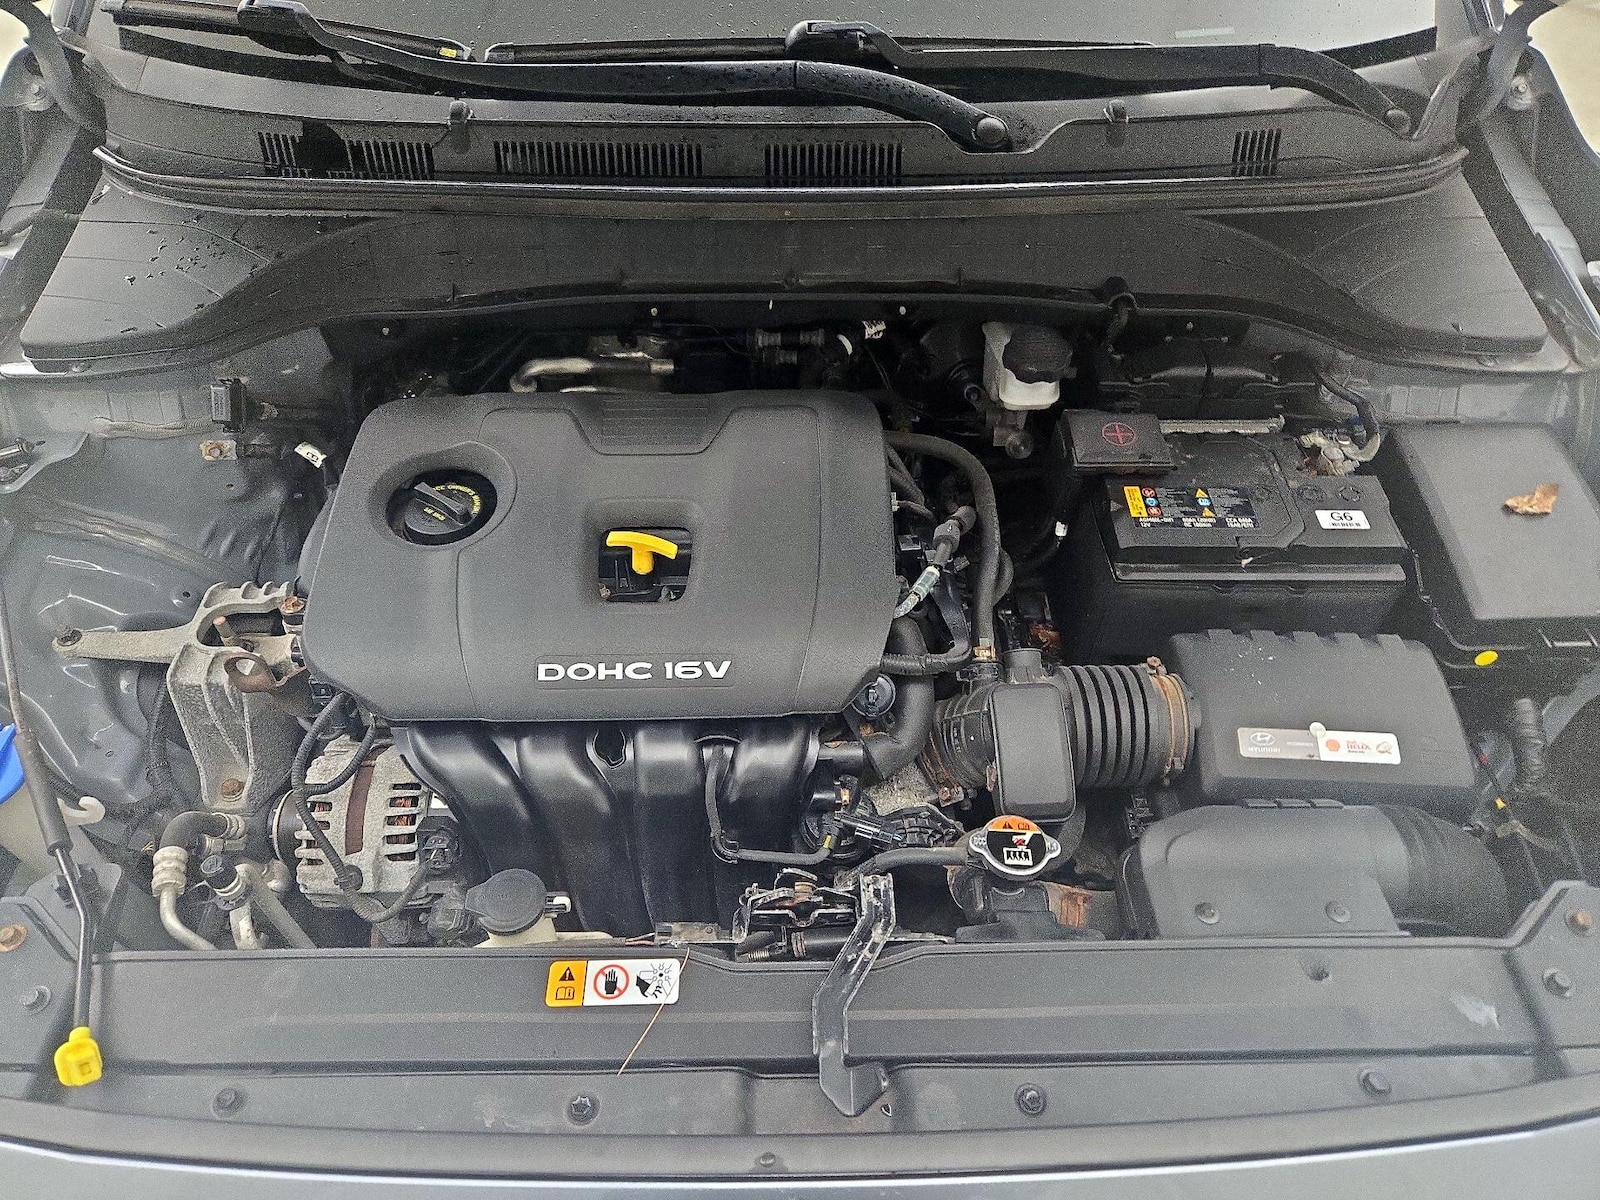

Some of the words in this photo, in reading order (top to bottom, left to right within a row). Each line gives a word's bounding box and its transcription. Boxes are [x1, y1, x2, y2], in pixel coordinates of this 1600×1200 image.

[1330, 511, 1353, 522] G6
[537, 661, 653, 681] DOHC
[664, 660, 732, 680] 16V
[1248, 746, 1281, 754] HYUNDAI
